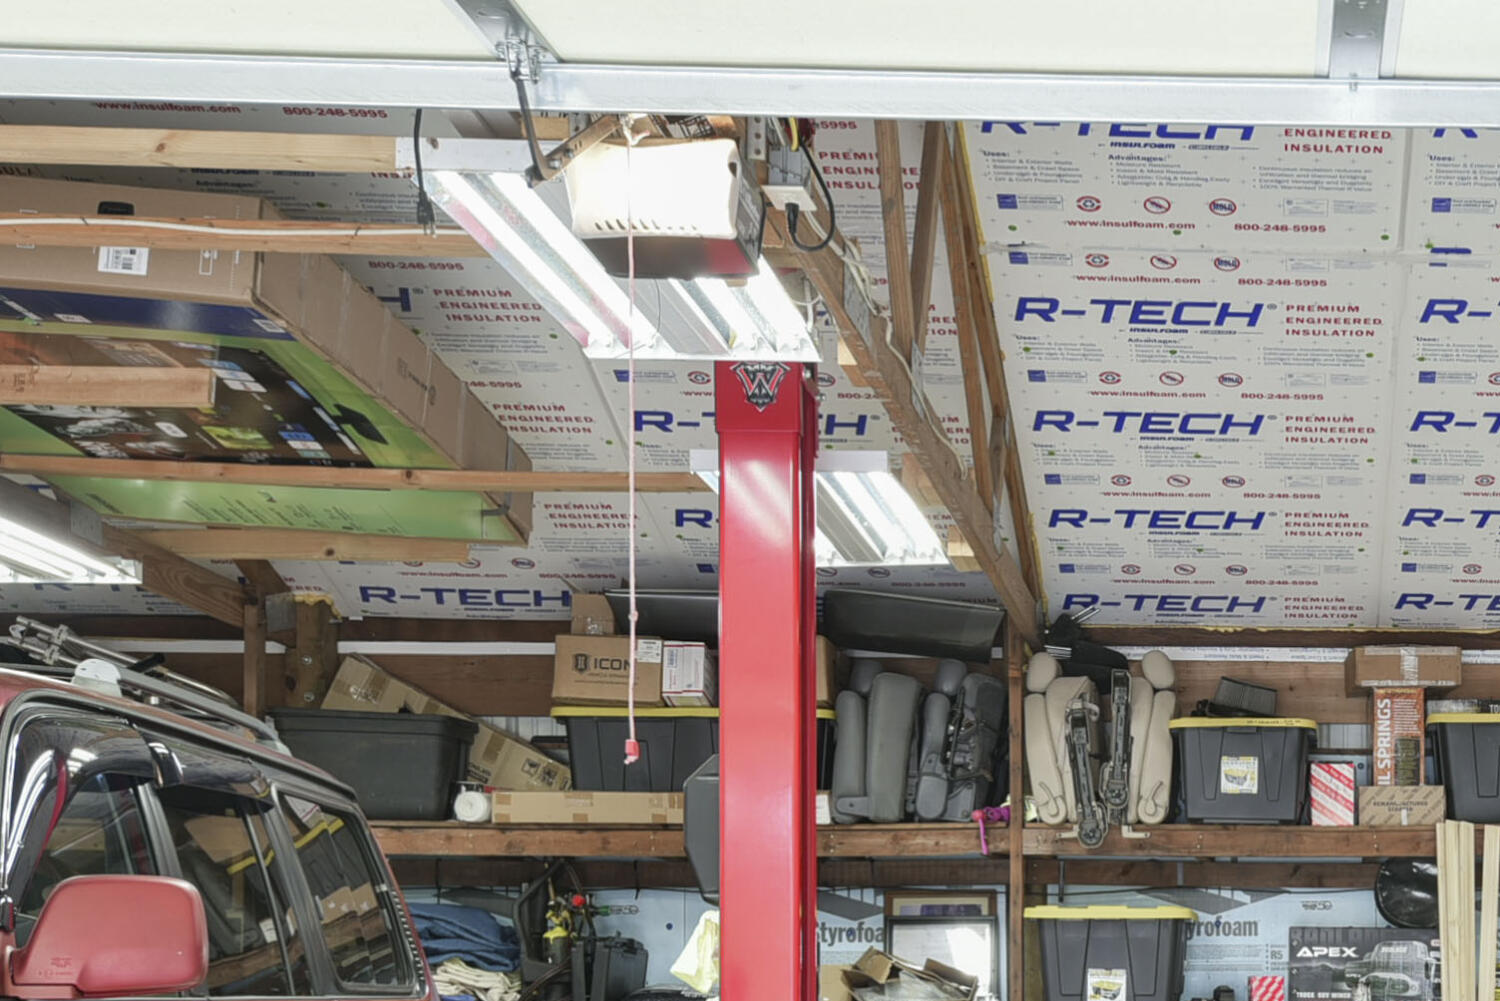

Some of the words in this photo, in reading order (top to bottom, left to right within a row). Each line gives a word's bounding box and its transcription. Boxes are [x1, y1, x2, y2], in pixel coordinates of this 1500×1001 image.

[1283, 127, 1392, 140] ENGINEERED
[1283, 143, 1385, 154] INSULATION
[1068, 219, 1197, 231] www.insulfoam.com
[1233, 223, 1327, 233] 800-248-5995
[367, 261, 465, 272] 800-248-5995
[1077, 274, 1203, 285] www.insulfoam.com
[1237, 277, 1329, 288] 800-248-5995
[432, 288, 513, 298] PREMIUM
[439, 301, 542, 311] ENGINEERED
[1285, 303, 1361, 313] PREMIUM
[447, 312, 544, 323] INSULATION
[1014, 298, 1264, 327] R-TECH
[1285, 316, 1383, 326] ENGINEERED
[1284, 327, 1377, 337] INSULATION
[1090, 389, 1205, 399] www.insulfoam.com
[1240, 391, 1325, 402] 800-248-5995
[493, 403, 567, 412] PREMIUM
[497, 413, 596, 426] ENGINEERED
[1033, 411, 1264, 435] R-TECH
[1284, 415, 1355, 424] PREMIUM
[1285, 425, 1376, 435] ENGINEERED
[1283, 435, 1369, 446] INSULATION
[543, 503, 614, 511] PREMIUM
[1048, 509, 1264, 530] R-TECH
[1284, 511, 1350, 519] PREMIUM
[1284, 519, 1369, 530] ENGINEERED
[1283, 530, 1364, 539] INSULATION
[358, 586, 571, 609] R-TECH
[1062, 593, 1264, 612] R-TECH
[1284, 595, 1345, 604] PREMIUM
[1284, 612, 1361, 621] INSULATION
[1377, 698, 1392, 769] SPRINGS
[816, 922, 884, 947] tyrofoa
[1186, 919, 1258, 942] yrofoam
[1296, 947, 1359, 957] APEX
